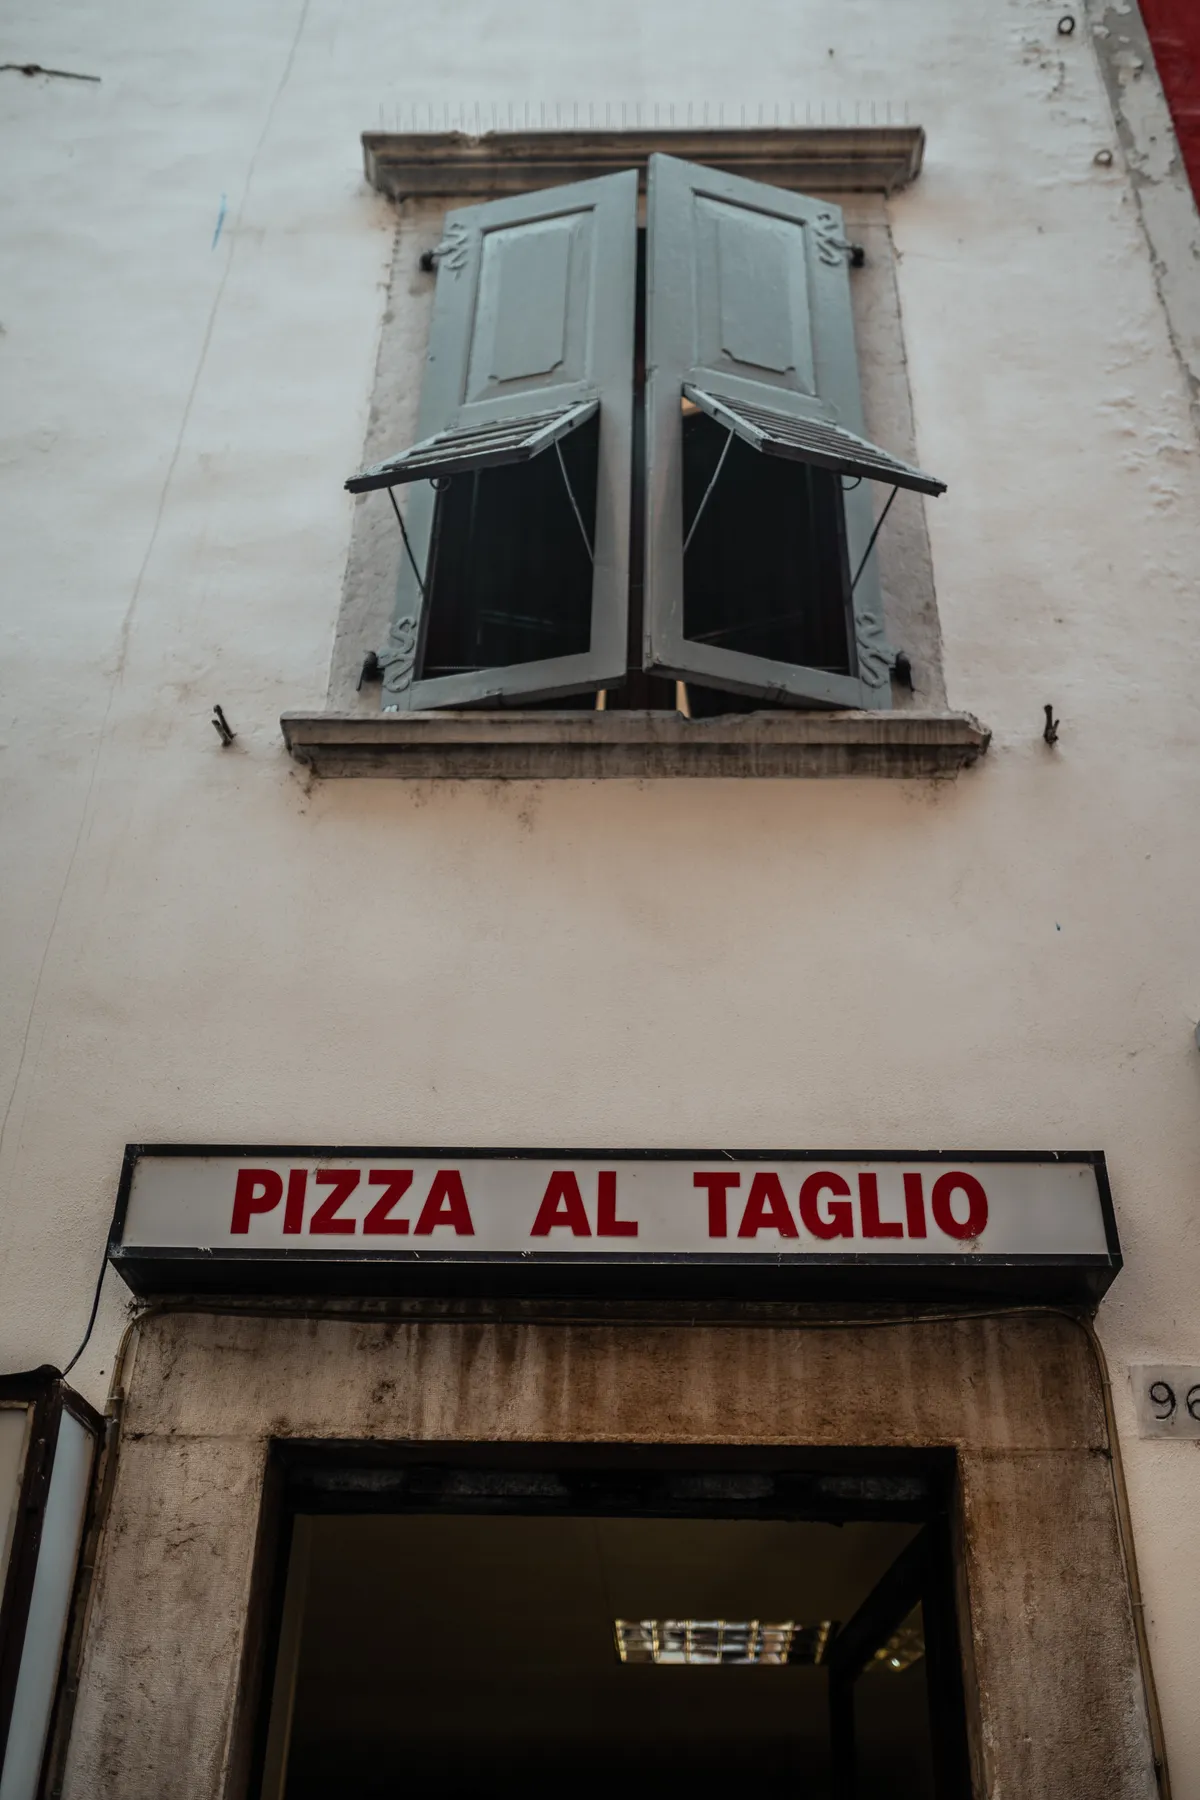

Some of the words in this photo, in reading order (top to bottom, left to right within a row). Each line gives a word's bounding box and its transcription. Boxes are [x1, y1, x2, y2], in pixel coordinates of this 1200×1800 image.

[230, 1168, 475, 1236] PIZZA
[529, 1170, 639, 1238] AL
[693, 1171, 988, 1240] TAGLIO
